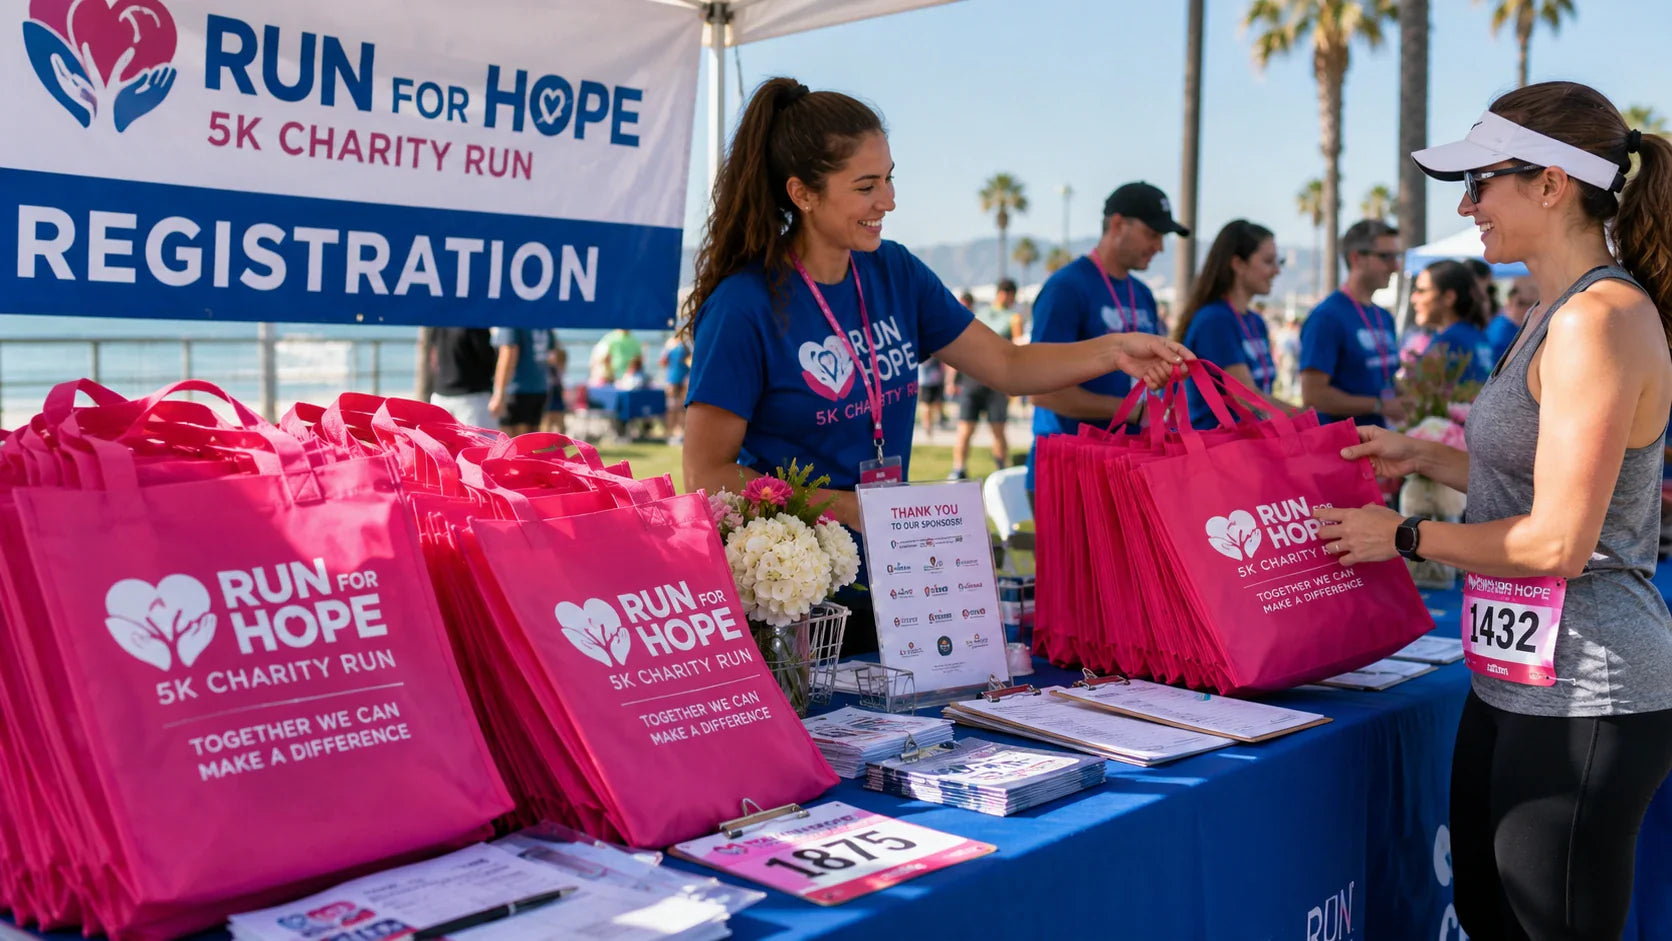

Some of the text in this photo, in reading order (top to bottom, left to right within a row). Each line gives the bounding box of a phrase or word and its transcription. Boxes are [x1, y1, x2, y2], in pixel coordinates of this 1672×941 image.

[205, 14, 643, 147] RUN FOR HOPE
[207, 111, 533, 180] 5K CHARITY RUN
[17, 204, 599, 302] REGISTRATION
[848, 316, 902, 356] RUN
[859, 342, 918, 384] HOPE
[816, 408, 839, 425] 5K
[845, 387, 902, 419] CHATY
[891, 504, 958, 519] THANK YOU
[903, 521, 919, 529] OUR
[1256, 496, 1311, 526] RUN
[1266, 518, 1338, 549] HOP
[217, 557, 378, 608] RUN FOR
[1238, 564, 1257, 578] 5K
[1260, 548, 1317, 571] CHARITY
[617, 580, 726, 623] RUN FOR
[1257, 568, 1354, 602] TOGETHER WE CAN
[1263, 600, 1292, 613] MAKE
[1304, 578, 1364, 602] DIFFERENCE
[1515, 583, 1551, 600] HOPE
[230, 593, 388, 654] HOPE
[635, 607, 743, 657] HOPE
[1471, 603, 1539, 653] 1432
[156, 649, 396, 705] 5K CHARITY RUN
[609, 648, 752, 690] 5K CHARITY RUN
[189, 702, 400, 756] TOGETHER WE CAN
[639, 691, 760, 728] TOGETHER WE CAN
[651, 707, 772, 745] MAKE A DIFFERENCE
[198, 723, 411, 781] MAKE A DIFFERENCE
[765, 830, 917, 878] 1875
